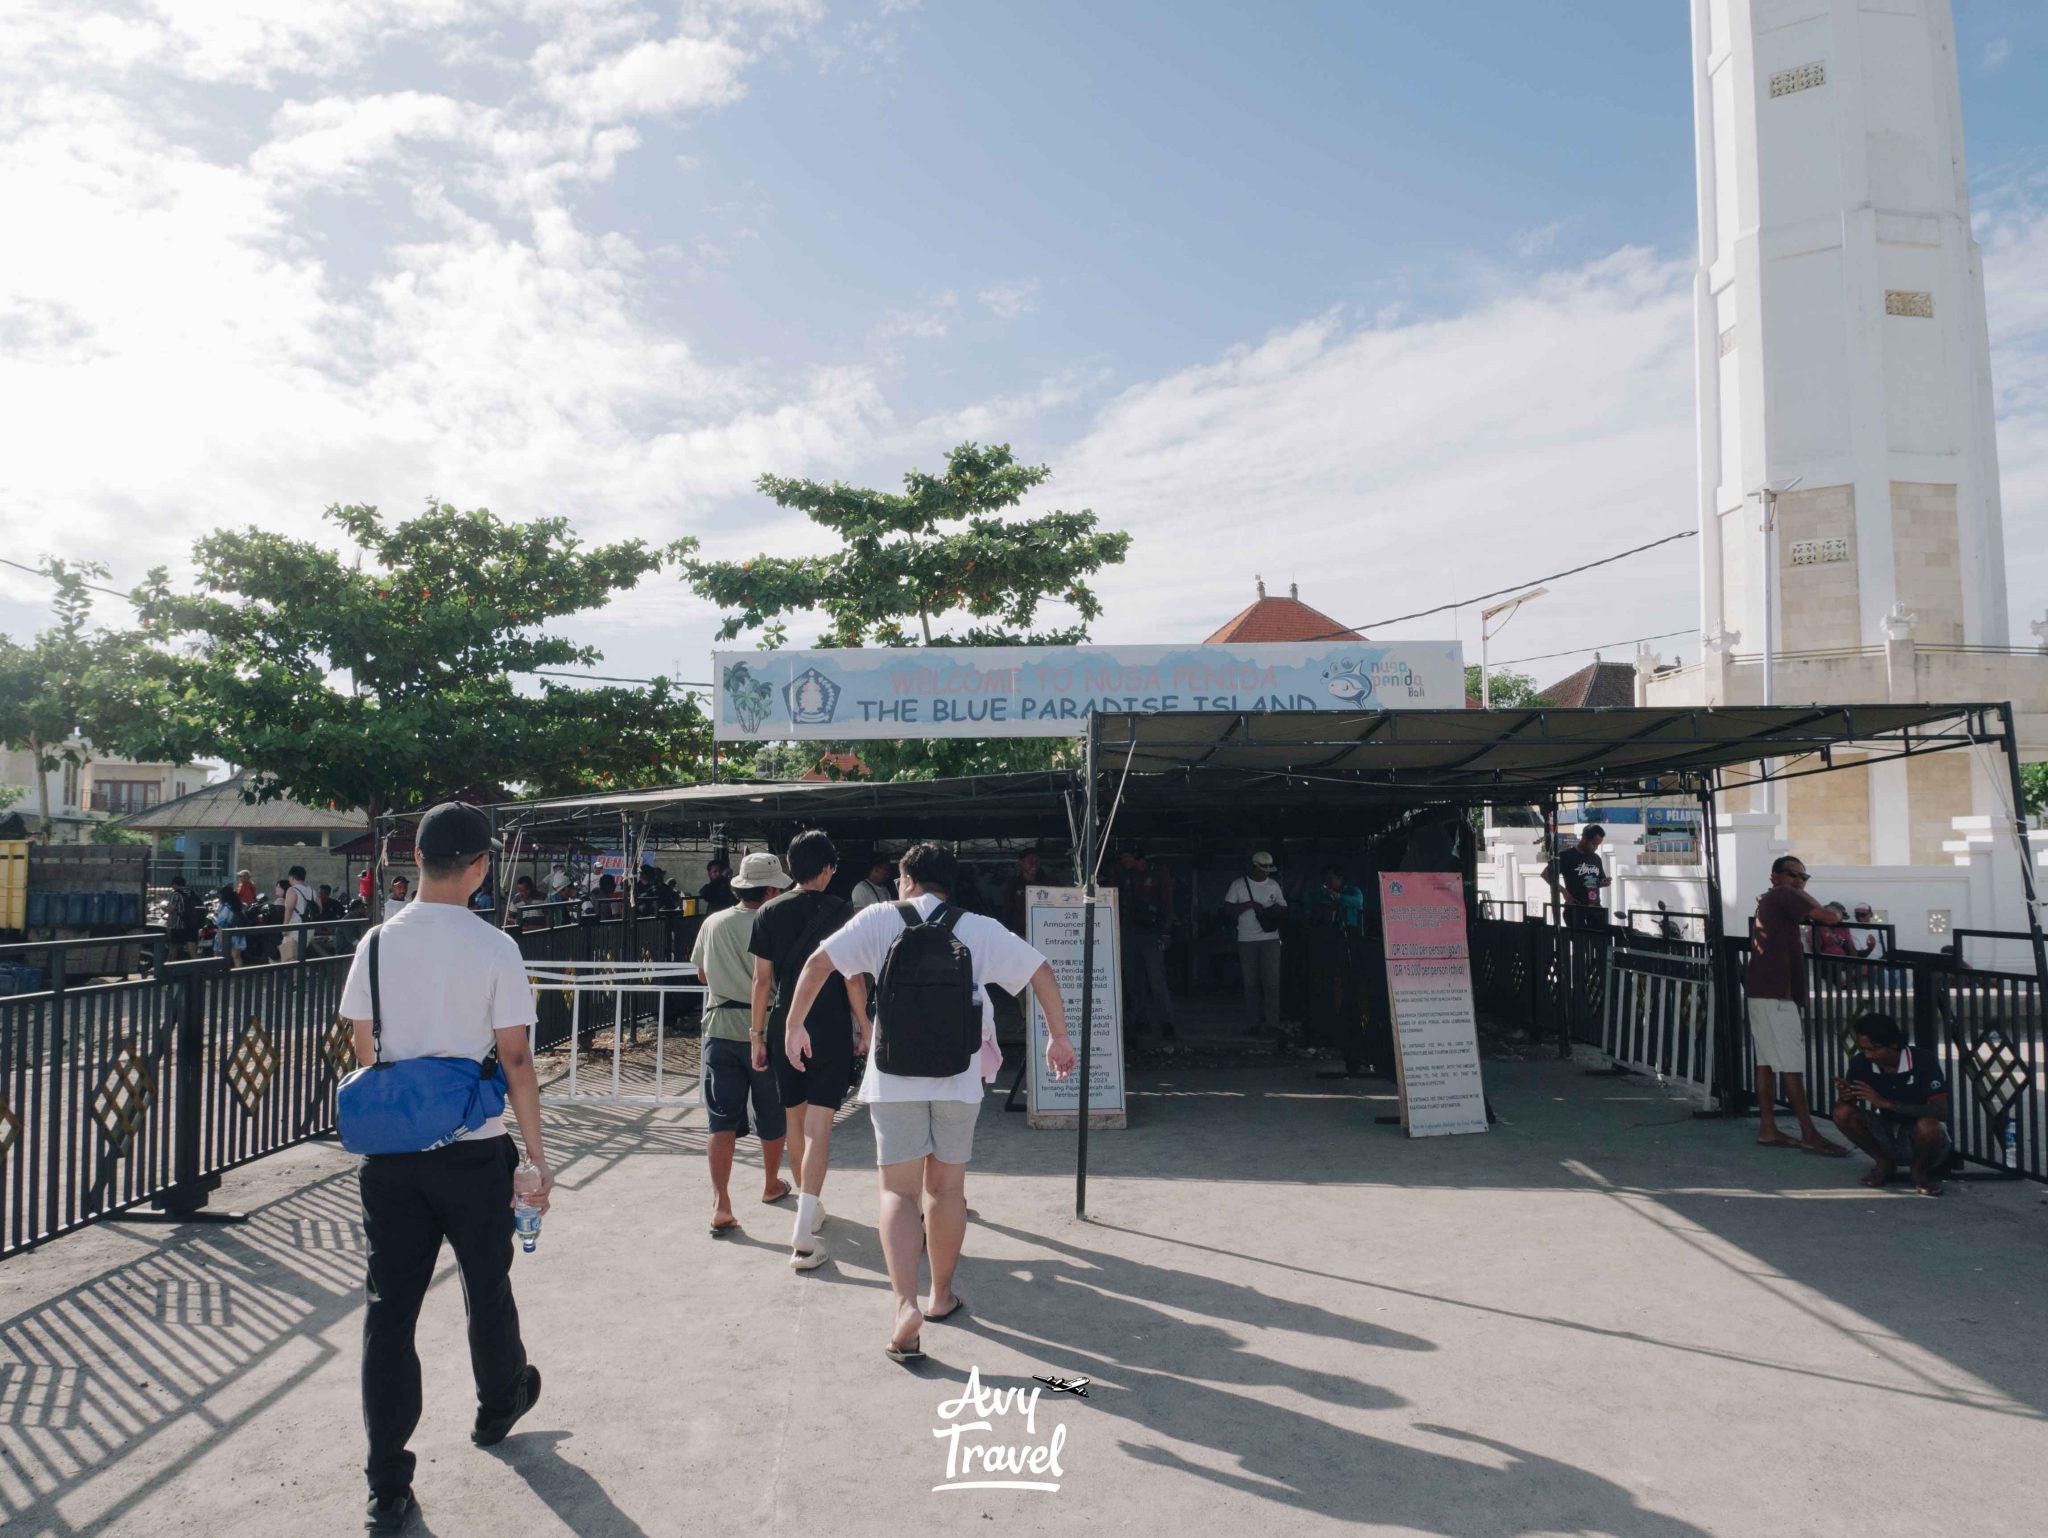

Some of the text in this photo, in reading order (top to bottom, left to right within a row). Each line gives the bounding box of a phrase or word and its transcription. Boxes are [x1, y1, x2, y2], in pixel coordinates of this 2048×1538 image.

[1371, 661, 1408, 673] nusa
[890, 665, 1278, 695] WELCOME TO NUSA PENIDA
[1372, 669, 1423, 693] penida
[1408, 686, 1425, 698] Bali
[856, 694, 1317, 723] THE BLUE PARADISE ISLAND
